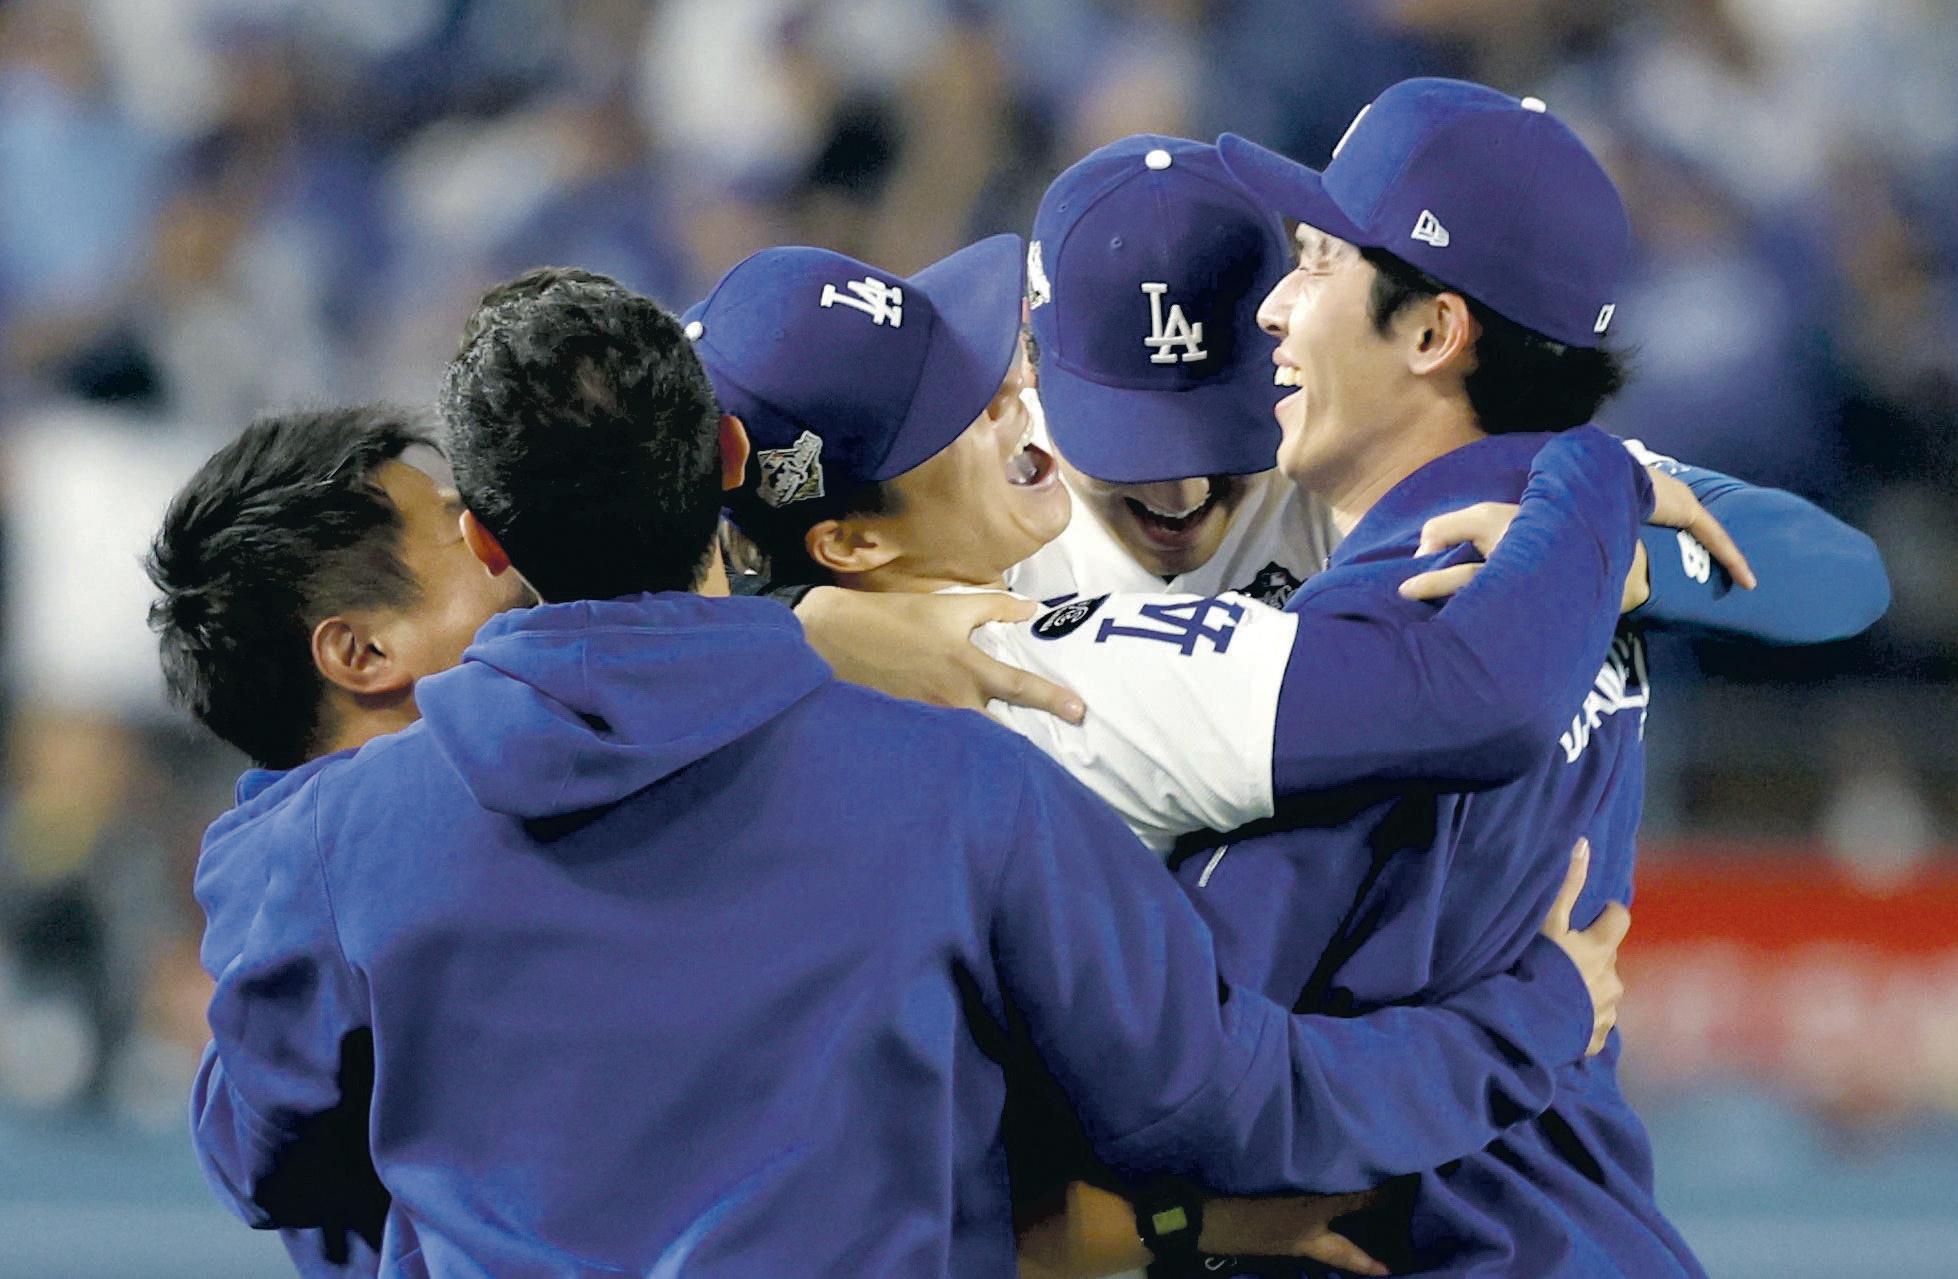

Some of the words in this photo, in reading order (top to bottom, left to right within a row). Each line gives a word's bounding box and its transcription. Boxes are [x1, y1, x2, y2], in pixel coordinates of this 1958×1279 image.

[820, 276, 903, 329] LA
[1141, 282, 1208, 364] LA
[1094, 597, 1246, 656] LA
